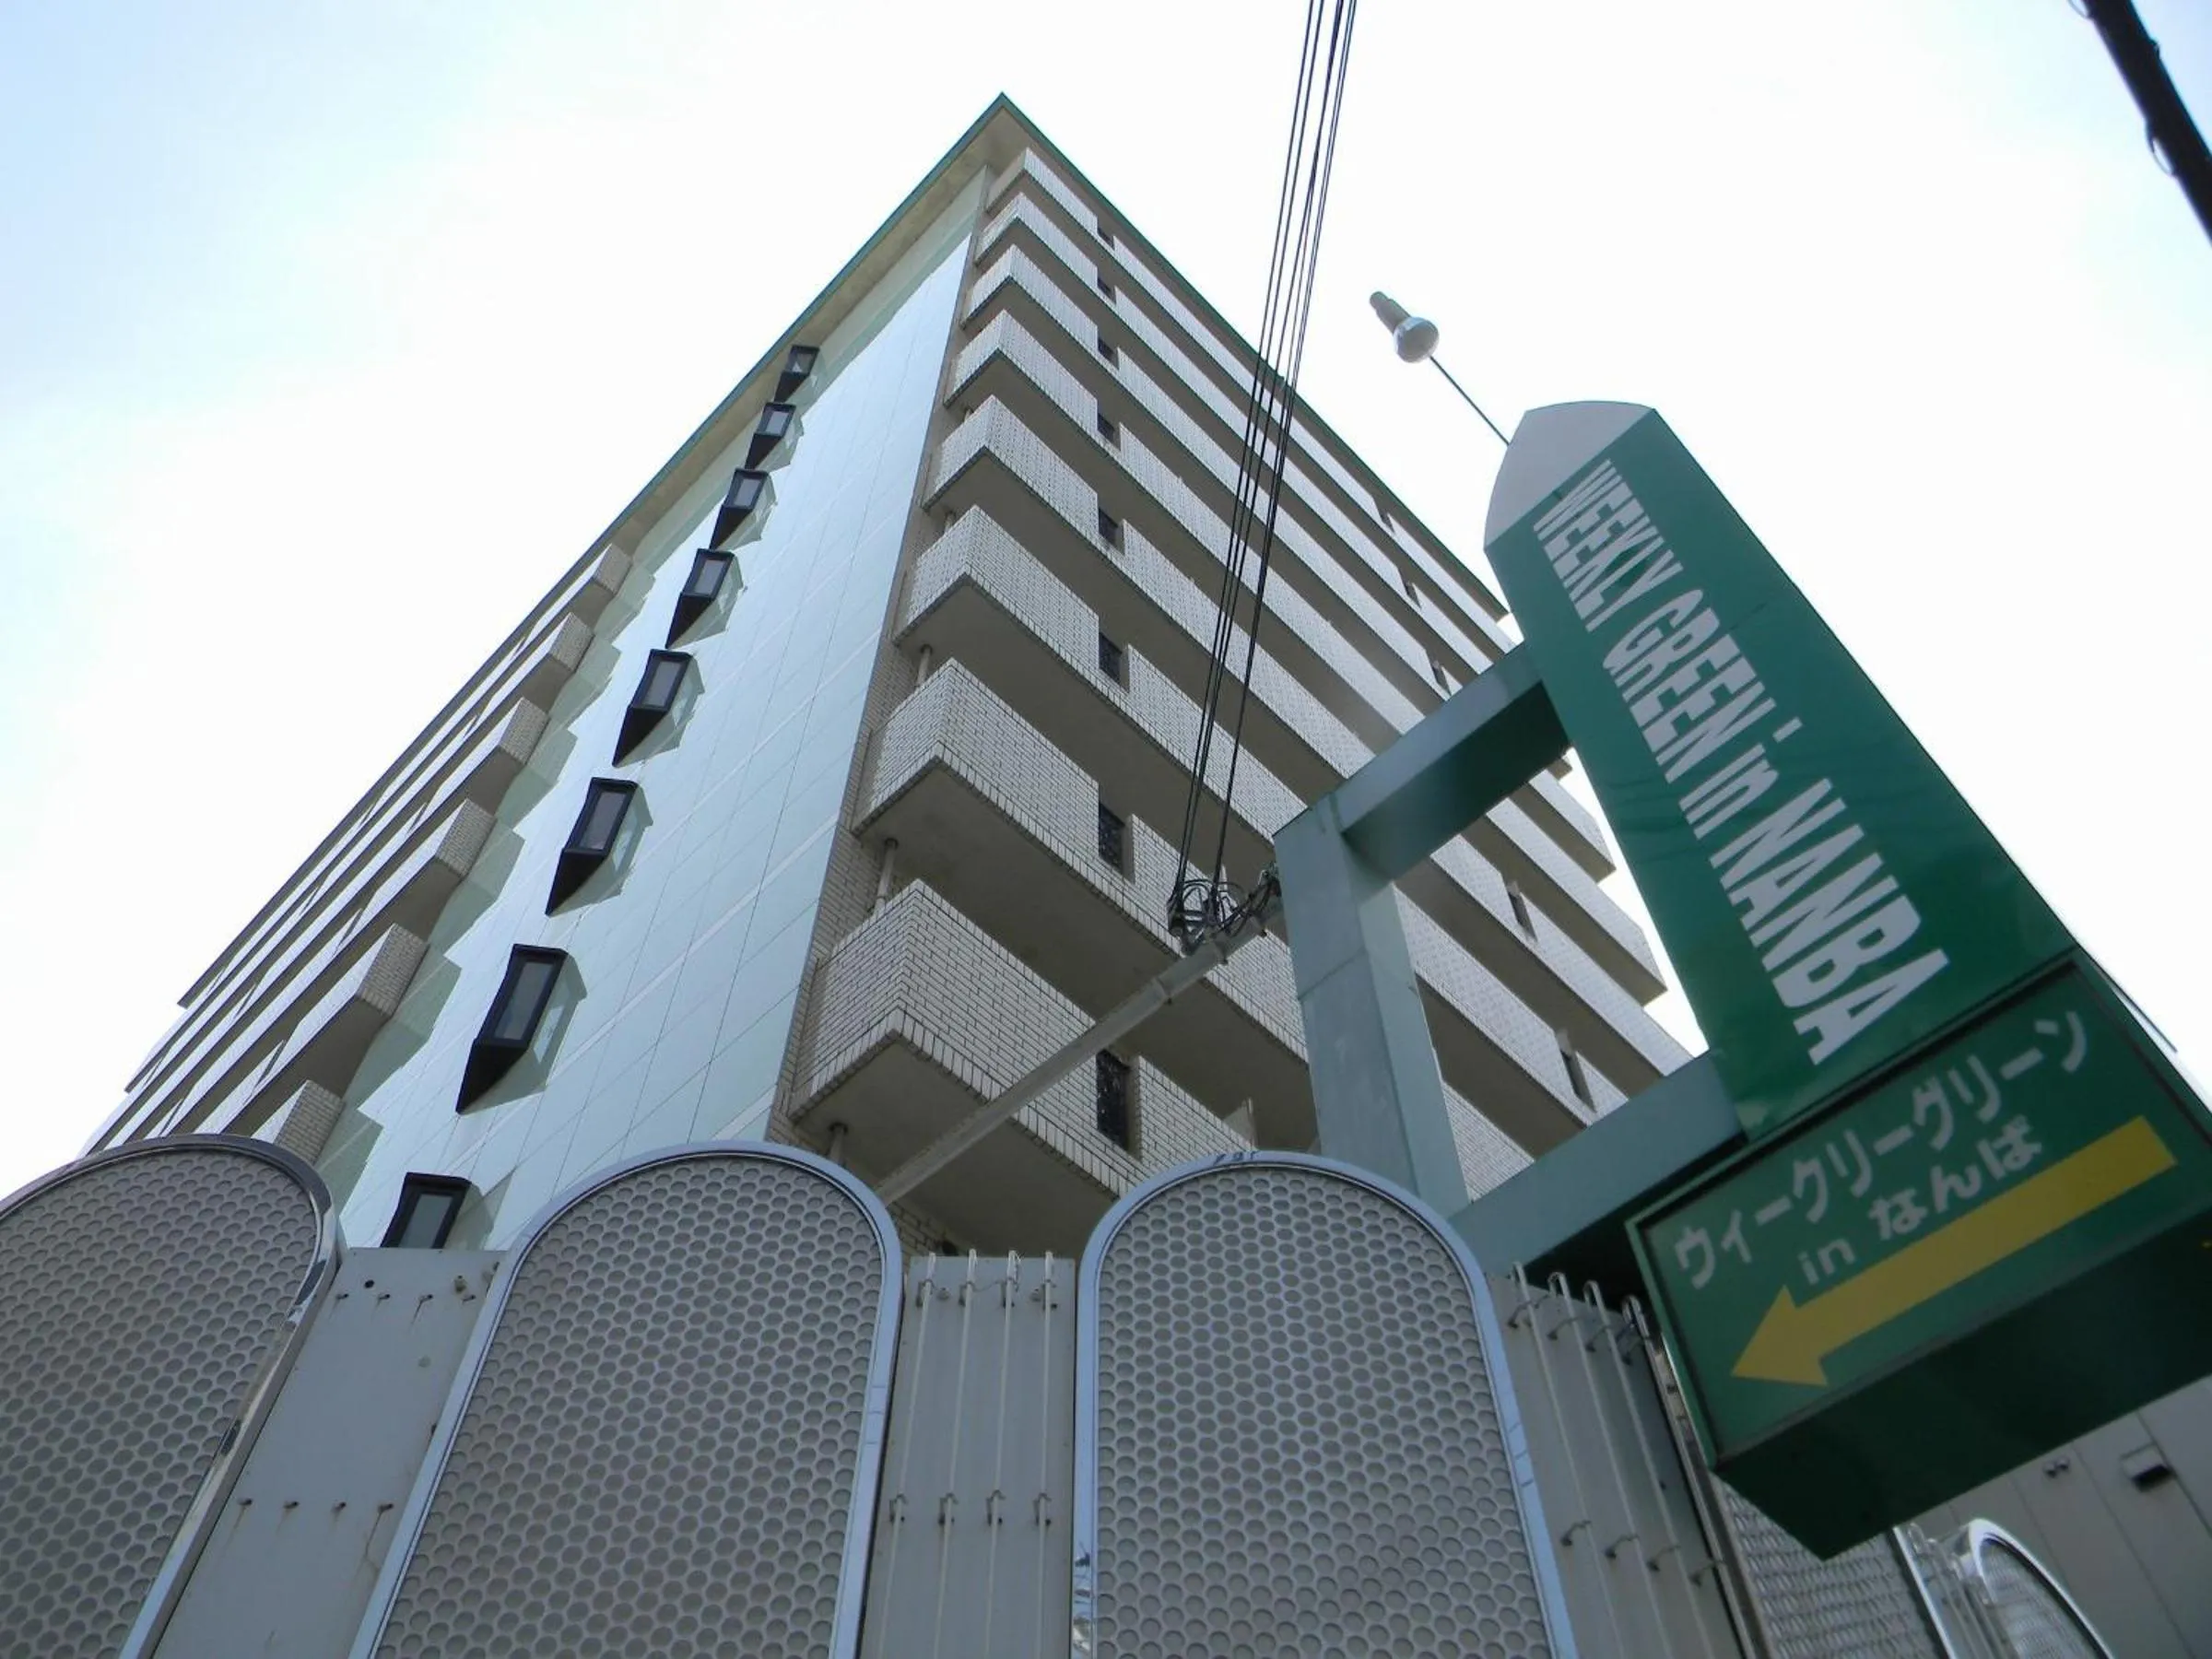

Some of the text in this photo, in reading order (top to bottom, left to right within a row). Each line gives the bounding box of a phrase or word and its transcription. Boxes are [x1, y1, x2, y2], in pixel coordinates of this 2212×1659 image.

[1533, 458, 1950, 1065] WEEKLY GREEN in NANBA
[1674, 1010, 2088, 1289] ウィークリーグリーン
[1798, 1114, 2042, 1285] in なんば
